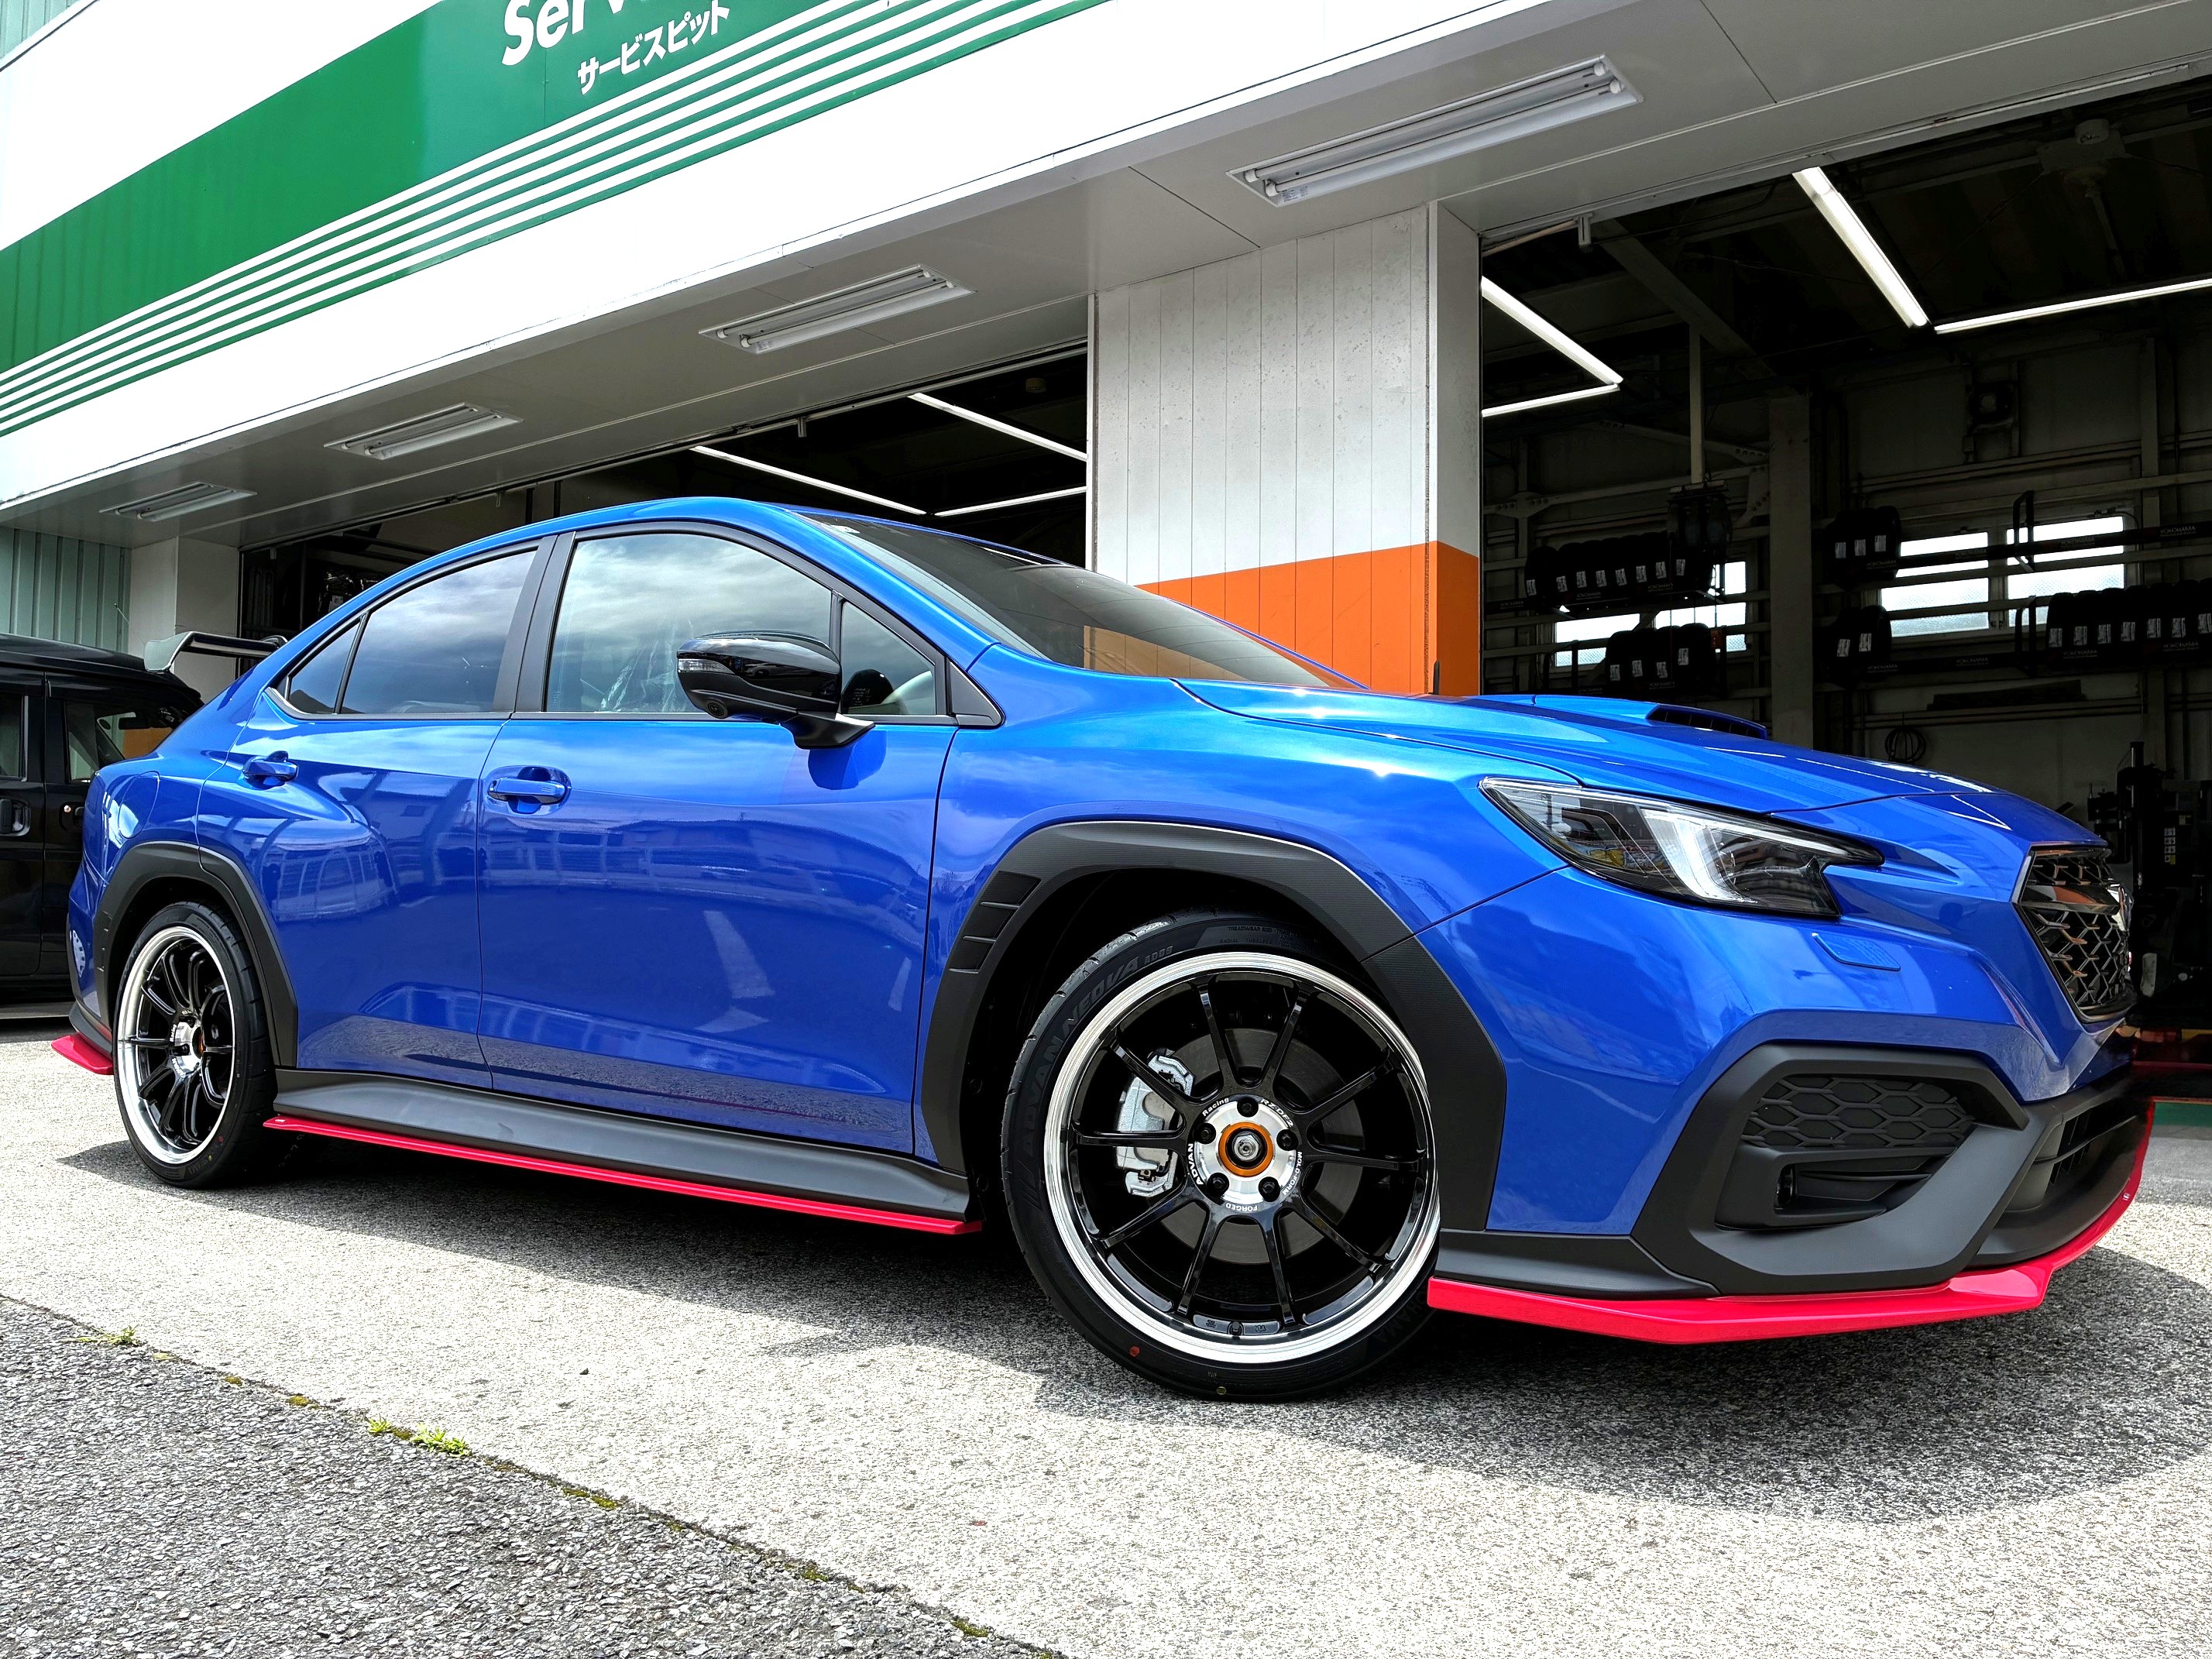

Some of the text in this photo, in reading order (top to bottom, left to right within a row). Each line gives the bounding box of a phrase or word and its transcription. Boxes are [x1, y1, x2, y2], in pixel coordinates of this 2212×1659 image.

[578, 0, 730, 95] サービスピット
[1187, 1097, 1229, 1185] ADVAN Racing
[1225, 1203, 1258, 1212] FORGED
